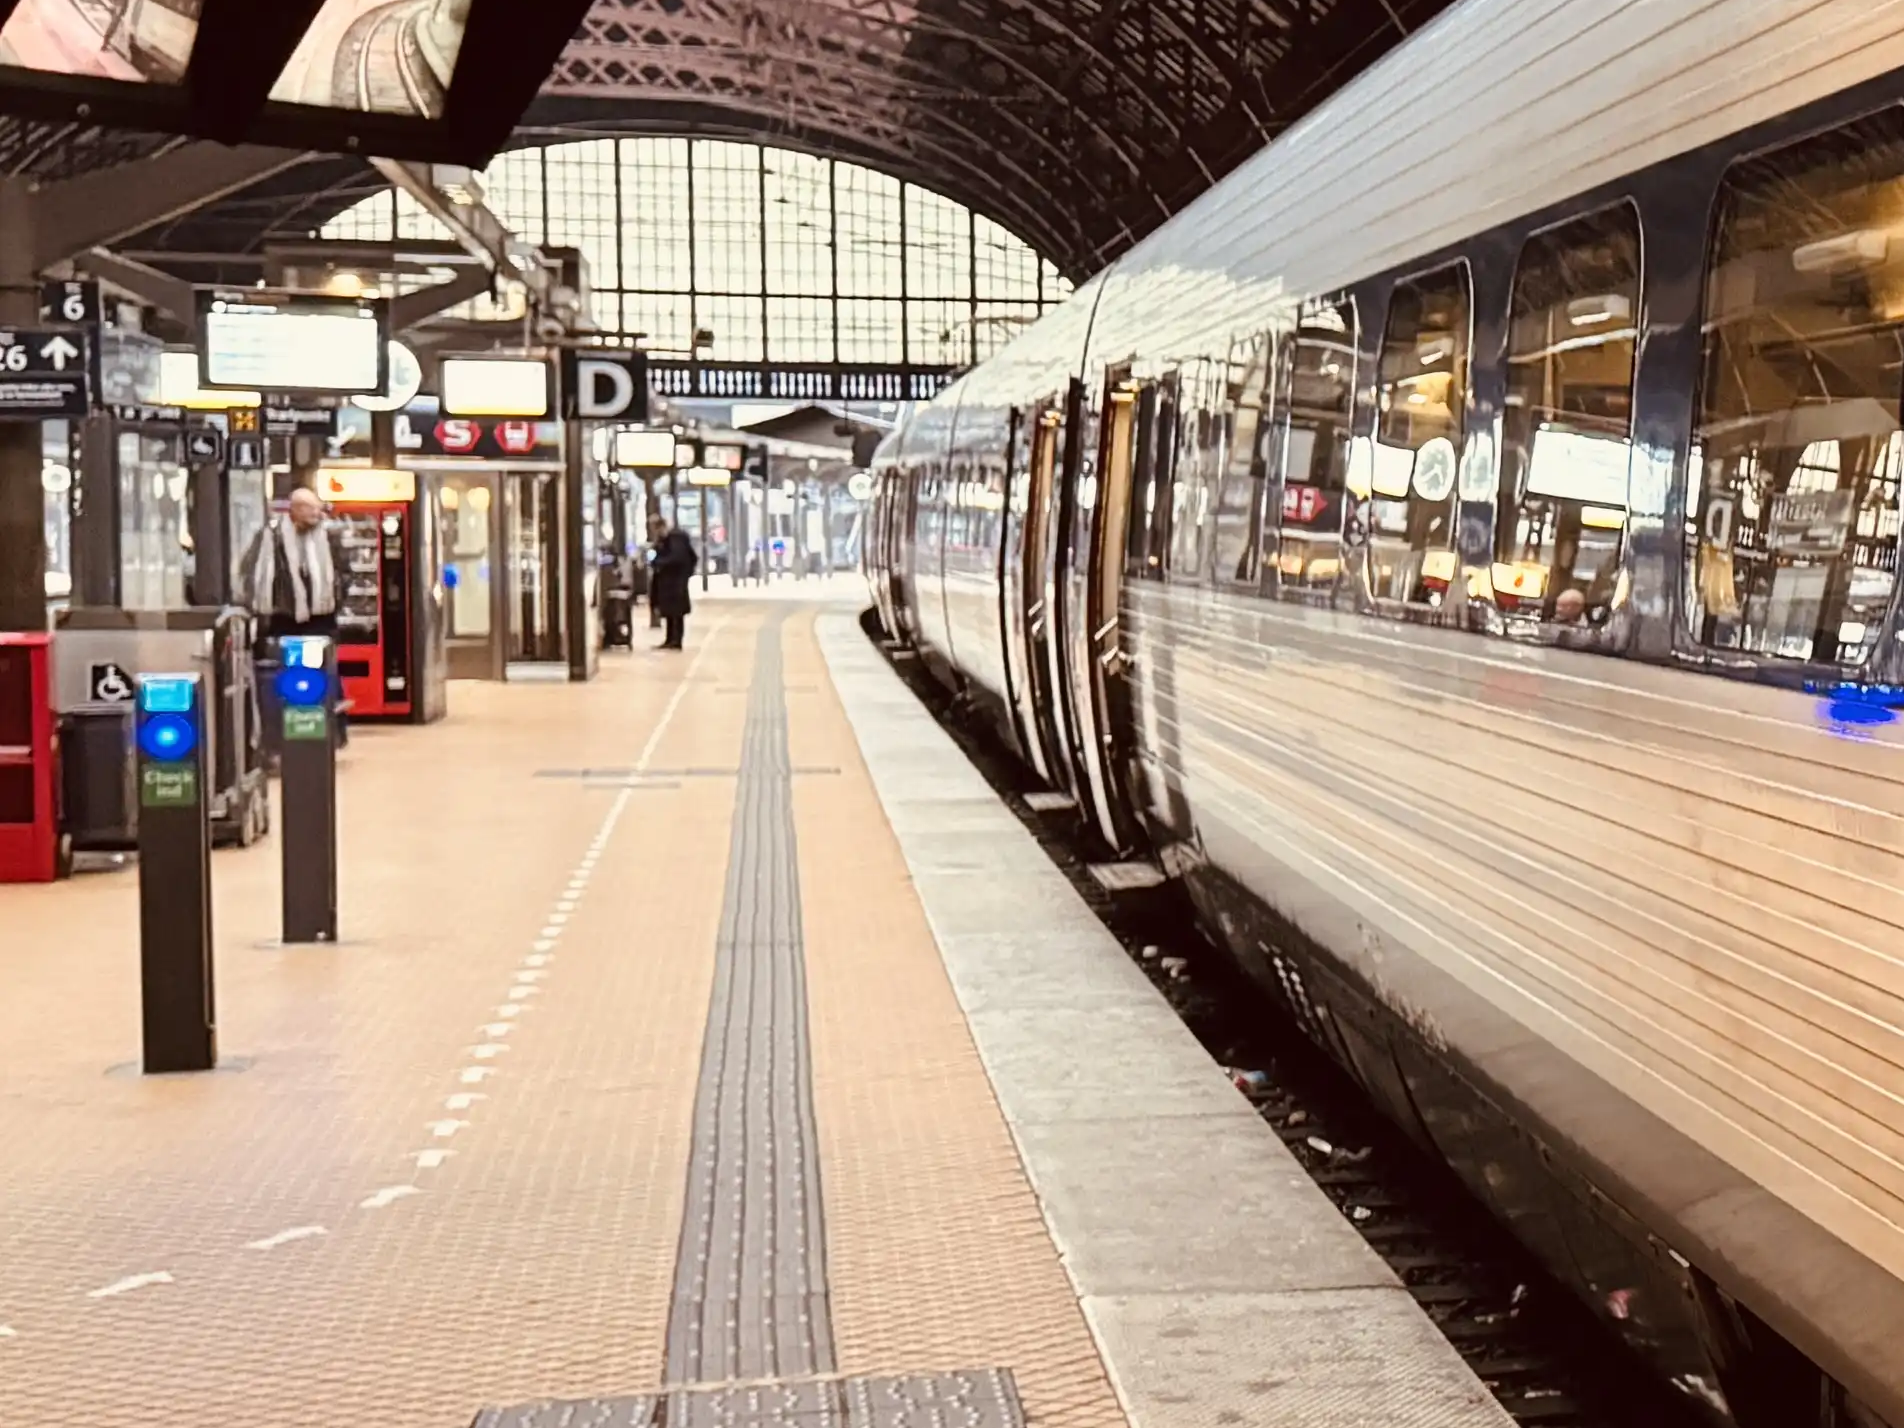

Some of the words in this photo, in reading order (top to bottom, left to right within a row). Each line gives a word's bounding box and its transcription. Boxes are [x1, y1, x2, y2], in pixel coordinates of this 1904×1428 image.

[63, 295, 85, 321] 6
[0, 344, 28, 371] 6
[577, 360, 634, 417] D
